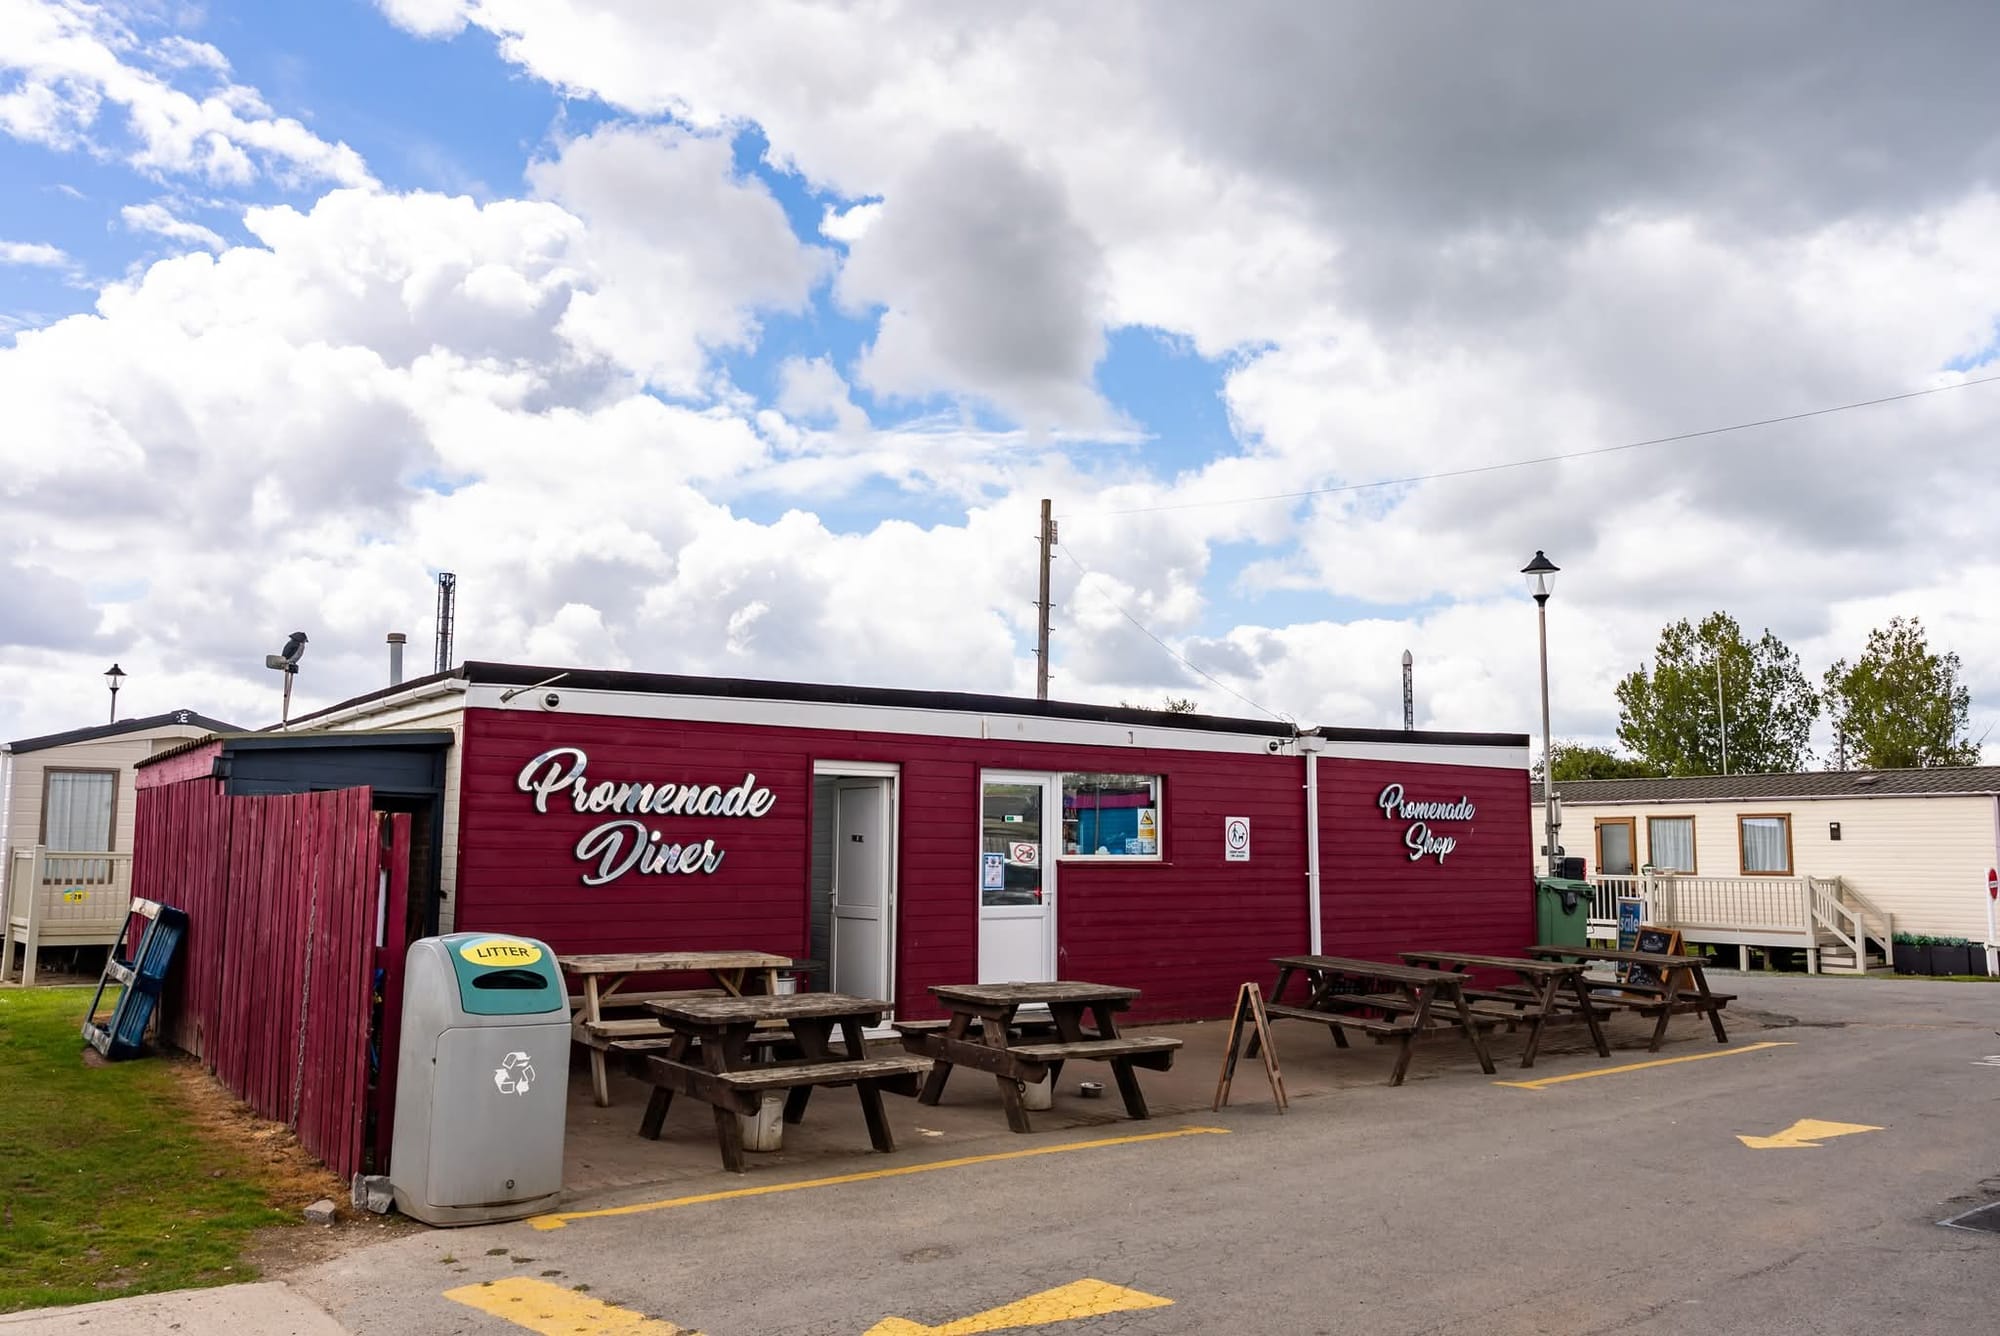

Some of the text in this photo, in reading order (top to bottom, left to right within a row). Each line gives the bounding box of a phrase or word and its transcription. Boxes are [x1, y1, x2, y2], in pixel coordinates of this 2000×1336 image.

[517, 747, 777, 818] Promenade
[1379, 783, 1476, 820] Promenade
[575, 819, 726, 886] Diner
[1405, 821, 1457, 865] Shop
[1619, 914, 1639, 932] sale
[476, 946, 530, 958] LITTER
